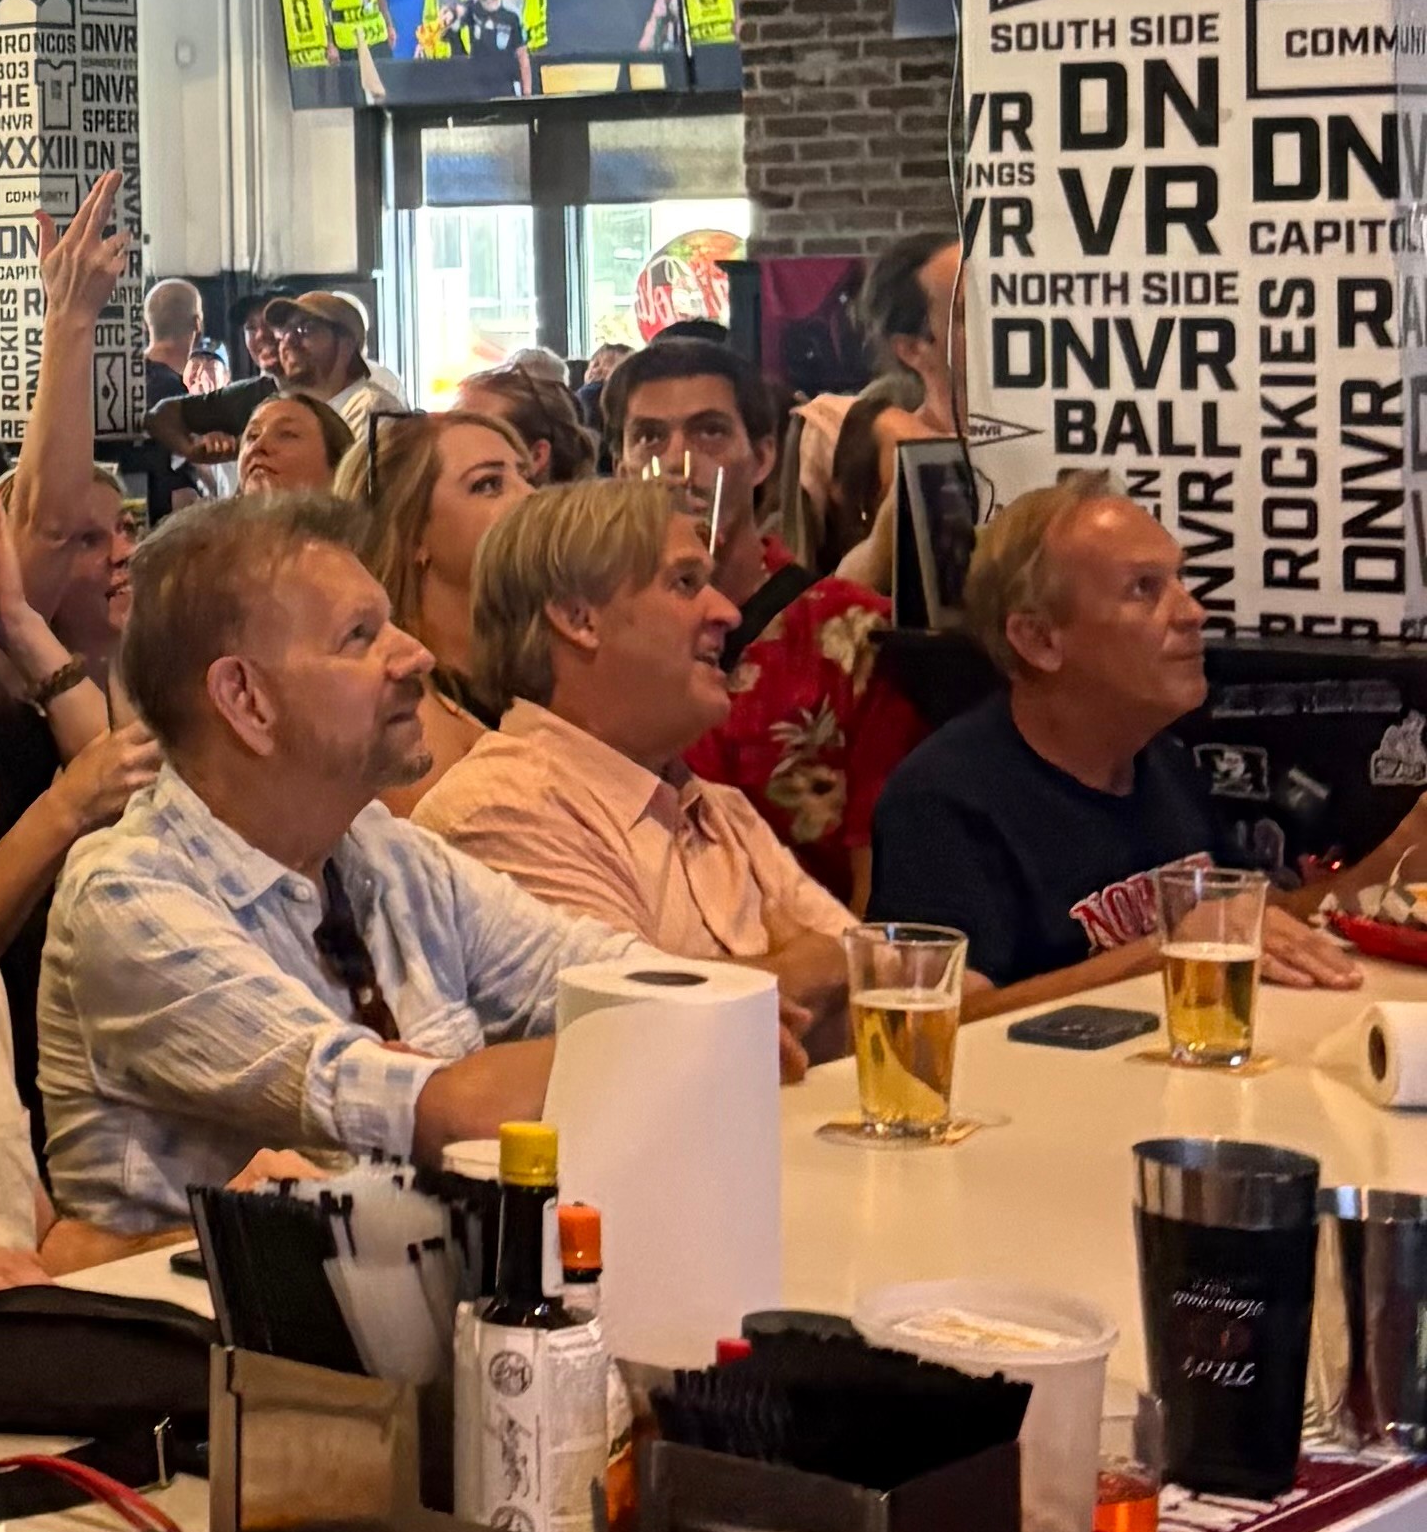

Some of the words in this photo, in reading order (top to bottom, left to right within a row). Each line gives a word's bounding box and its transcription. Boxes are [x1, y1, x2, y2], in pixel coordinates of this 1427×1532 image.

[990, 18, 1116, 54] SOUTH
[1129, 13, 1220, 47] SIDE
[991, 272, 1129, 306] NORTH
[1143, 271, 1239, 304] SIDE
[1, 289, 19, 411] ROCKIES
[992, 317, 1238, 390] DNVR
[1055, 399, 1241, 457] BALL
[1260, 278, 1320, 590] ROCKIES
[1341, 377, 1405, 593] DNVR
